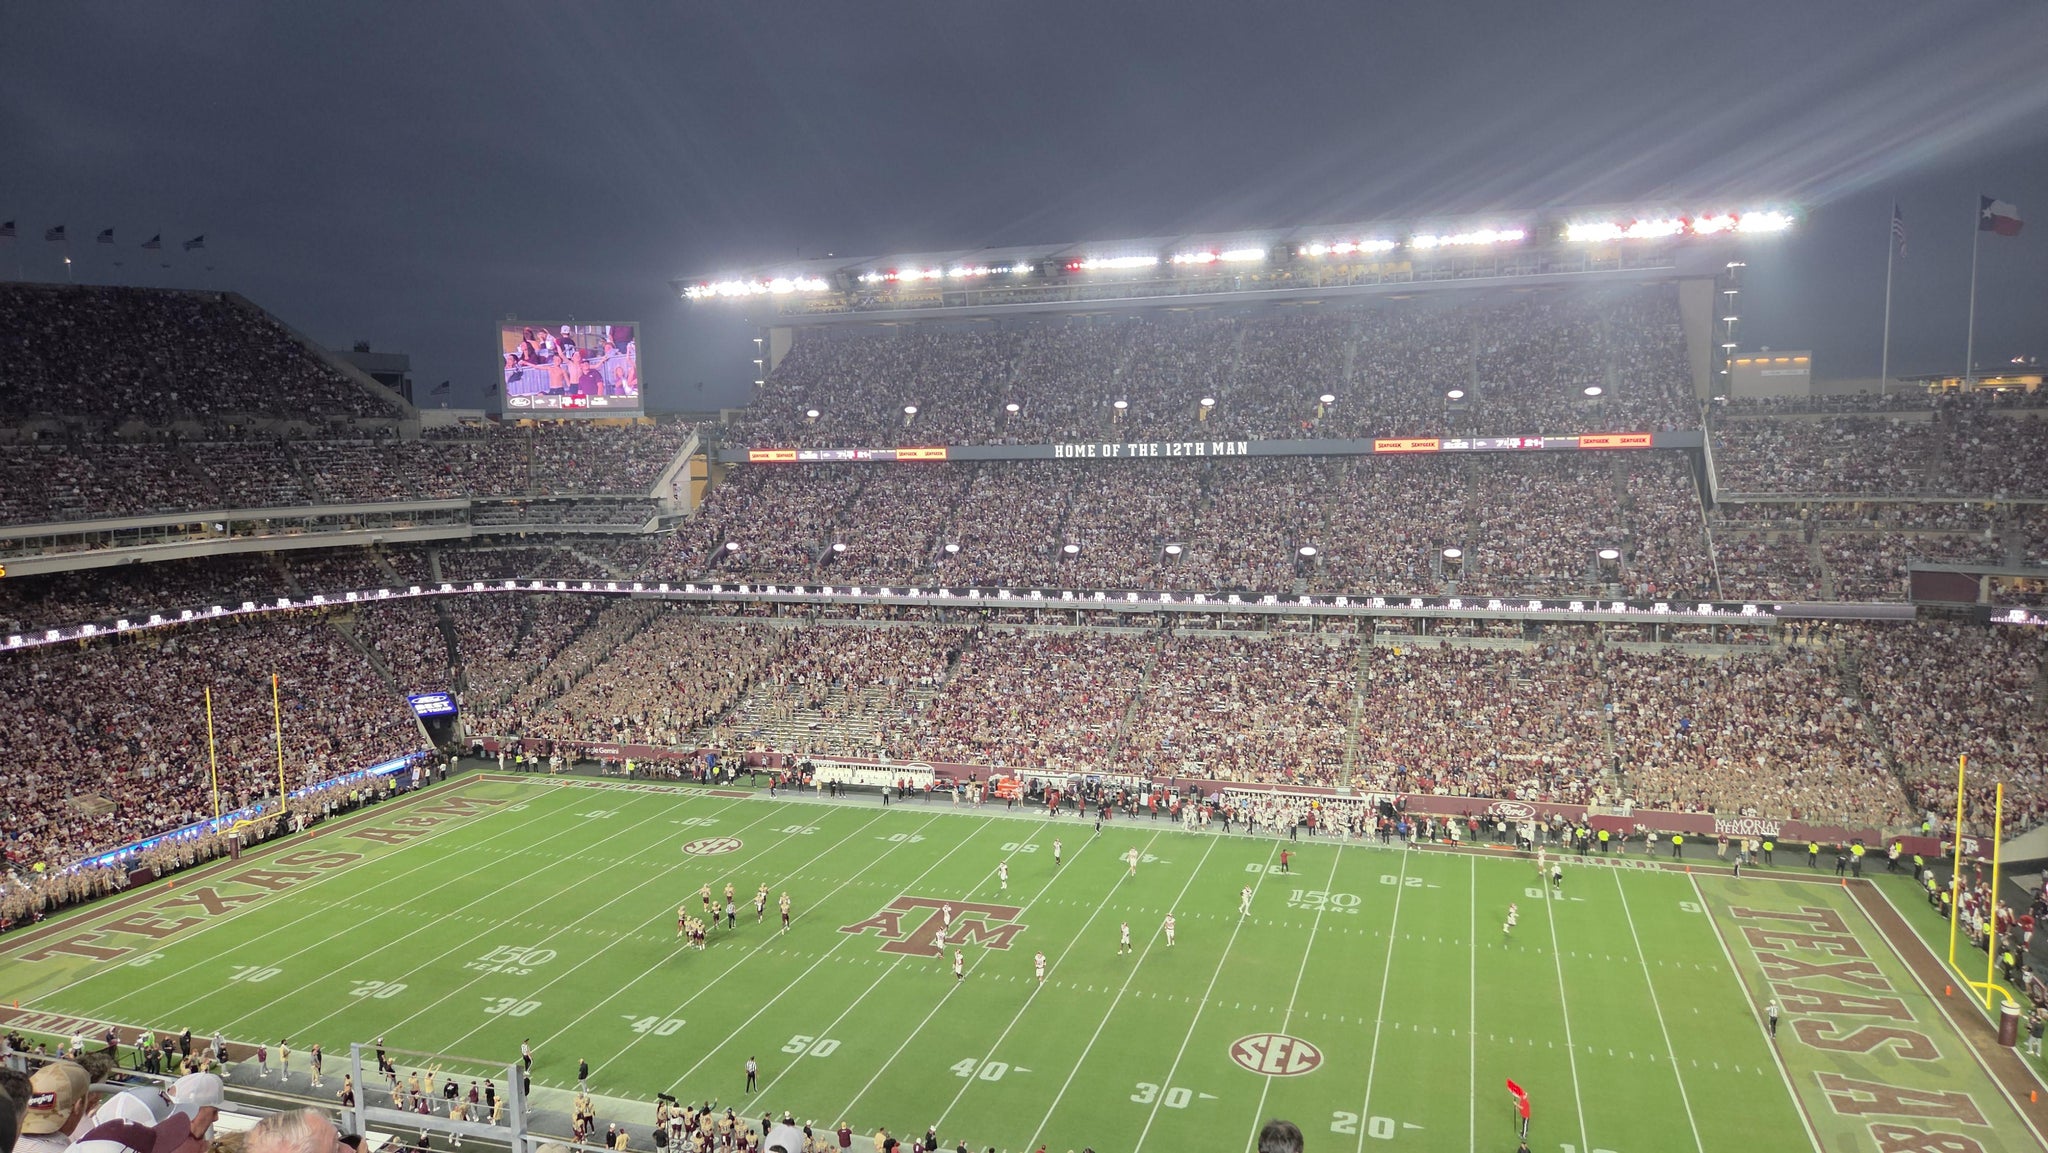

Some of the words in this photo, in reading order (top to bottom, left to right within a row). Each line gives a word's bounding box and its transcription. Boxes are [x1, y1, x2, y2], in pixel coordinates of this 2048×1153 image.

[1055, 444, 1096, 458] HOME
[1102, 443, 1121, 457] OF
[1128, 443, 1158, 457] THE
[1166, 442, 1205, 456] 12TH
[1212, 441, 1248, 455] MAN
[1496, 803, 1528, 817] Ford
[343, 795, 508, 845] A&M
[1715, 818, 1780, 829] MEMORIAL
[781, 825, 821, 835] 30
[887, 833, 926, 843] 40
[684, 838, 739, 855] SEC
[1000, 842, 1040, 853] 50
[1560, 854, 1660, 871] GRIND
[1380, 874, 1423, 887] 20
[1290, 890, 1362, 908] 150
[1524, 888, 1565, 901] 10
[17, 850, 364, 962] TEXAS
[1286, 902, 1360, 914] YEARS
[477, 945, 557, 966] 150
[229, 966, 283, 982] 10
[462, 961, 533, 976] YEARS
[349, 981, 408, 999] 20
[1728, 905, 1944, 1063] TEXAS
[483, 997, 542, 1017] 30
[5, 1012, 113, 1039] GRIND
[630, 1015, 687, 1036] 40
[781, 1035, 841, 1057] 50
[1237, 1036, 1316, 1074] SEC
[949, 1057, 1009, 1082] 40
[1130, 1082, 1193, 1109] 30
[1330, 1111, 1395, 1140] 20
